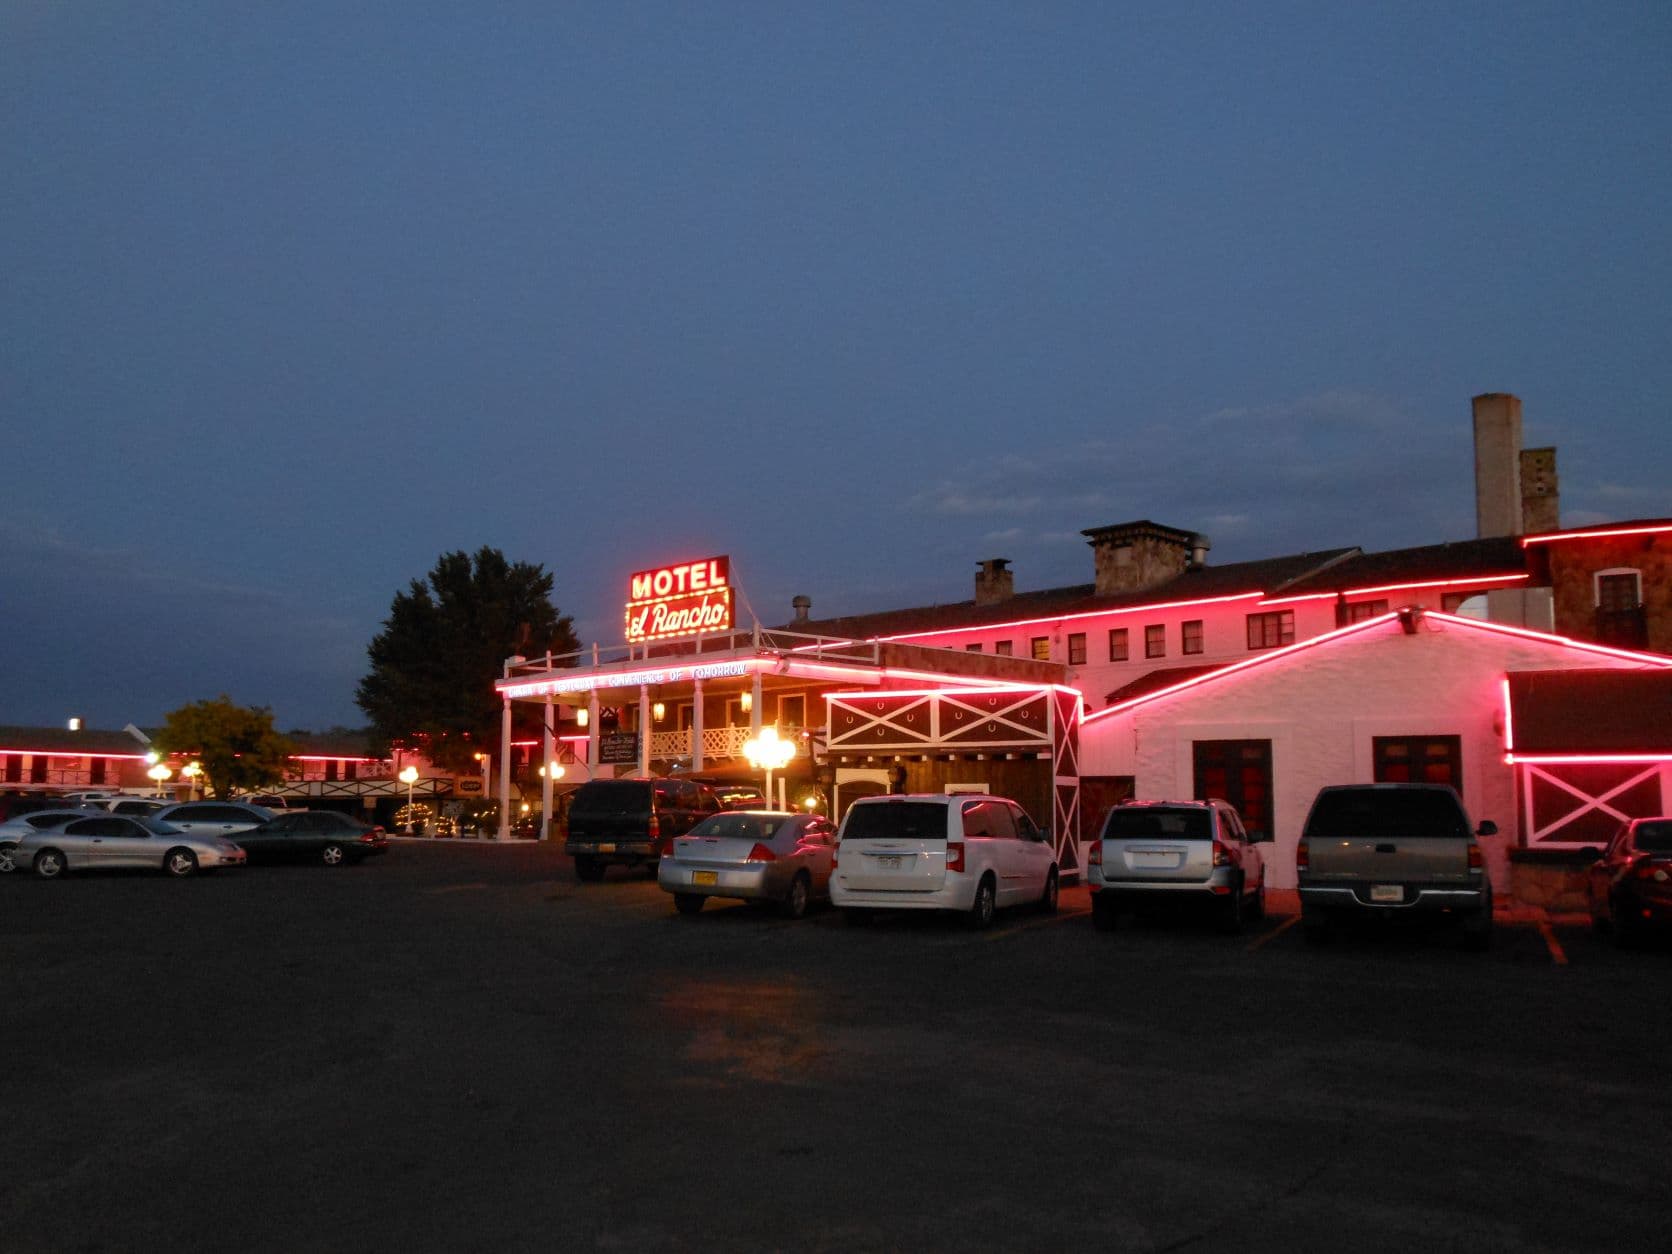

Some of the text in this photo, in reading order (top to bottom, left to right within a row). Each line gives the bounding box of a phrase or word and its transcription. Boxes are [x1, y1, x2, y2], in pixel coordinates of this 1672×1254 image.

[632, 560, 725, 600] MOTEL
[651, 595, 725, 633] Rancho
[670, 670, 683, 681] OF
[692, 663, 746, 680] TOMORROW
